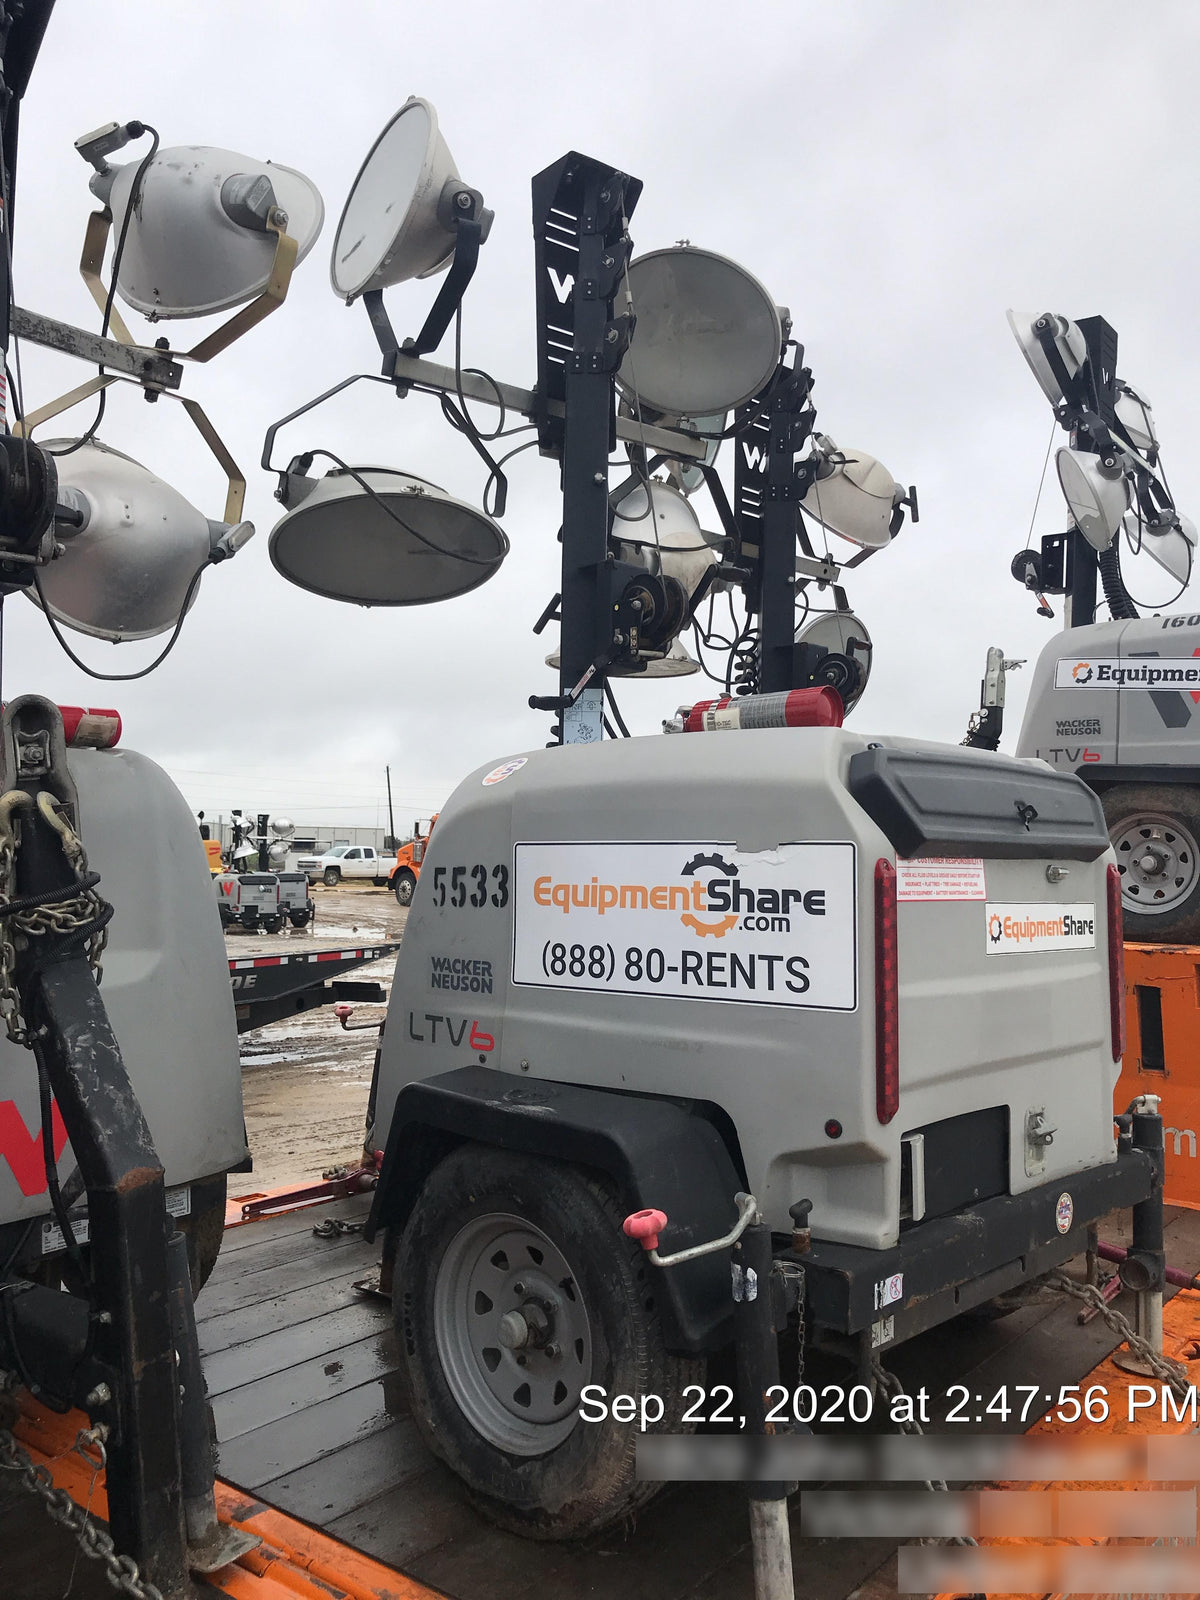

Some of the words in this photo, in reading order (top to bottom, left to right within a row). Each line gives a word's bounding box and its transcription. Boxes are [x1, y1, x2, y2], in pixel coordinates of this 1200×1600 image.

[1097, 665, 1200, 685] Equipme
[1056, 719, 1100, 729] WACKER
[1056, 727, 1101, 736] NEUSON
[433, 864, 509, 908] 5533
[533, 876, 826, 915] EquipmentShare
[738, 915, 791, 932] .com
[1003, 915, 1094, 942] EquipmentShare
[431, 956, 493, 978] WACKER
[541, 940, 616, 982] (888)
[624, 947, 811, 994] 80-RENTS
[431, 973, 493, 994] NEUSON
[408, 1011, 495, 1052] LTV6
